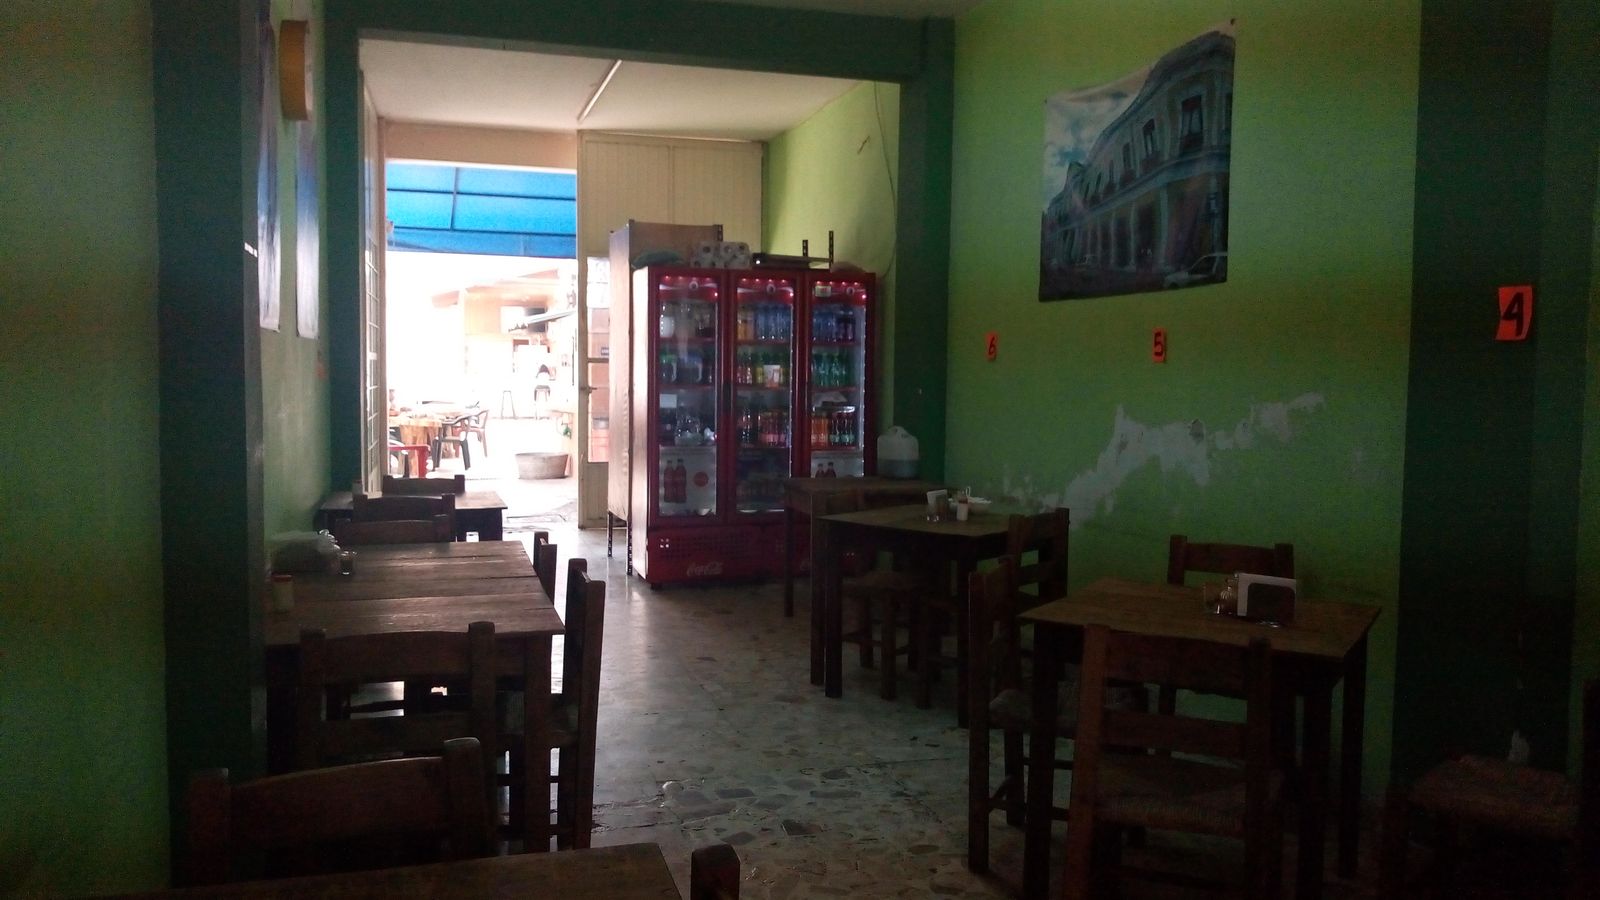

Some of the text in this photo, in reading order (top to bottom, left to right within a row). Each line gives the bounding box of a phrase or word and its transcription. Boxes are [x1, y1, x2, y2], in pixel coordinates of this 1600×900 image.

[1503, 292, 1524, 337] 4
[988, 336, 996, 355] 6
[1154, 332, 1164, 356] 5
